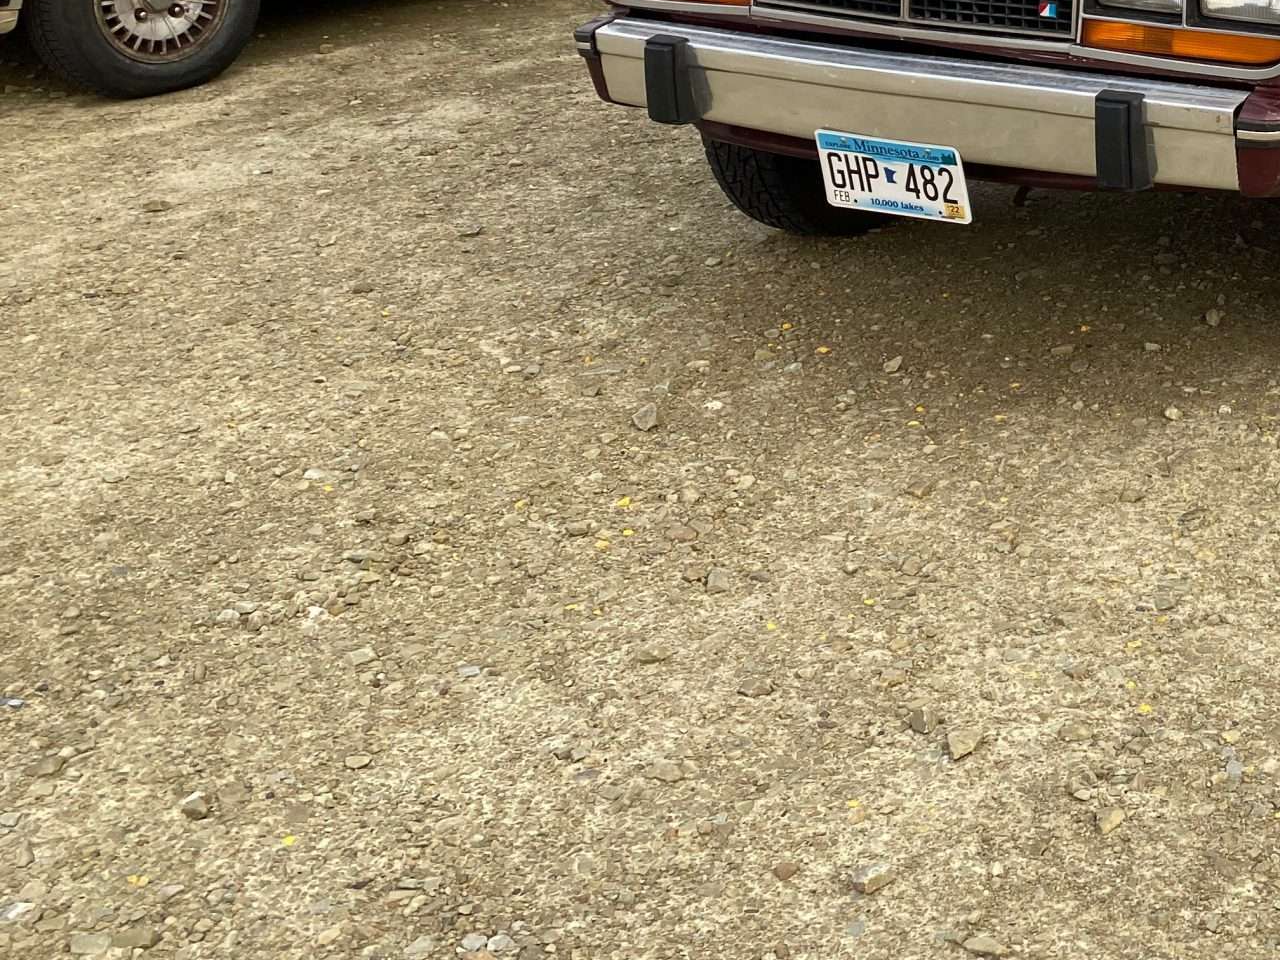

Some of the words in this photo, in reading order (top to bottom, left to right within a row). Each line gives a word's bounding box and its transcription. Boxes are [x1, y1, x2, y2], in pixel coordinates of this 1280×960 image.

[827, 152, 880, 193] GHP
[905, 163, 959, 205] 482
[834, 189, 851, 203] FEB
[870, 197, 899, 209] 10,000
[900, 201, 925, 213] lakes
